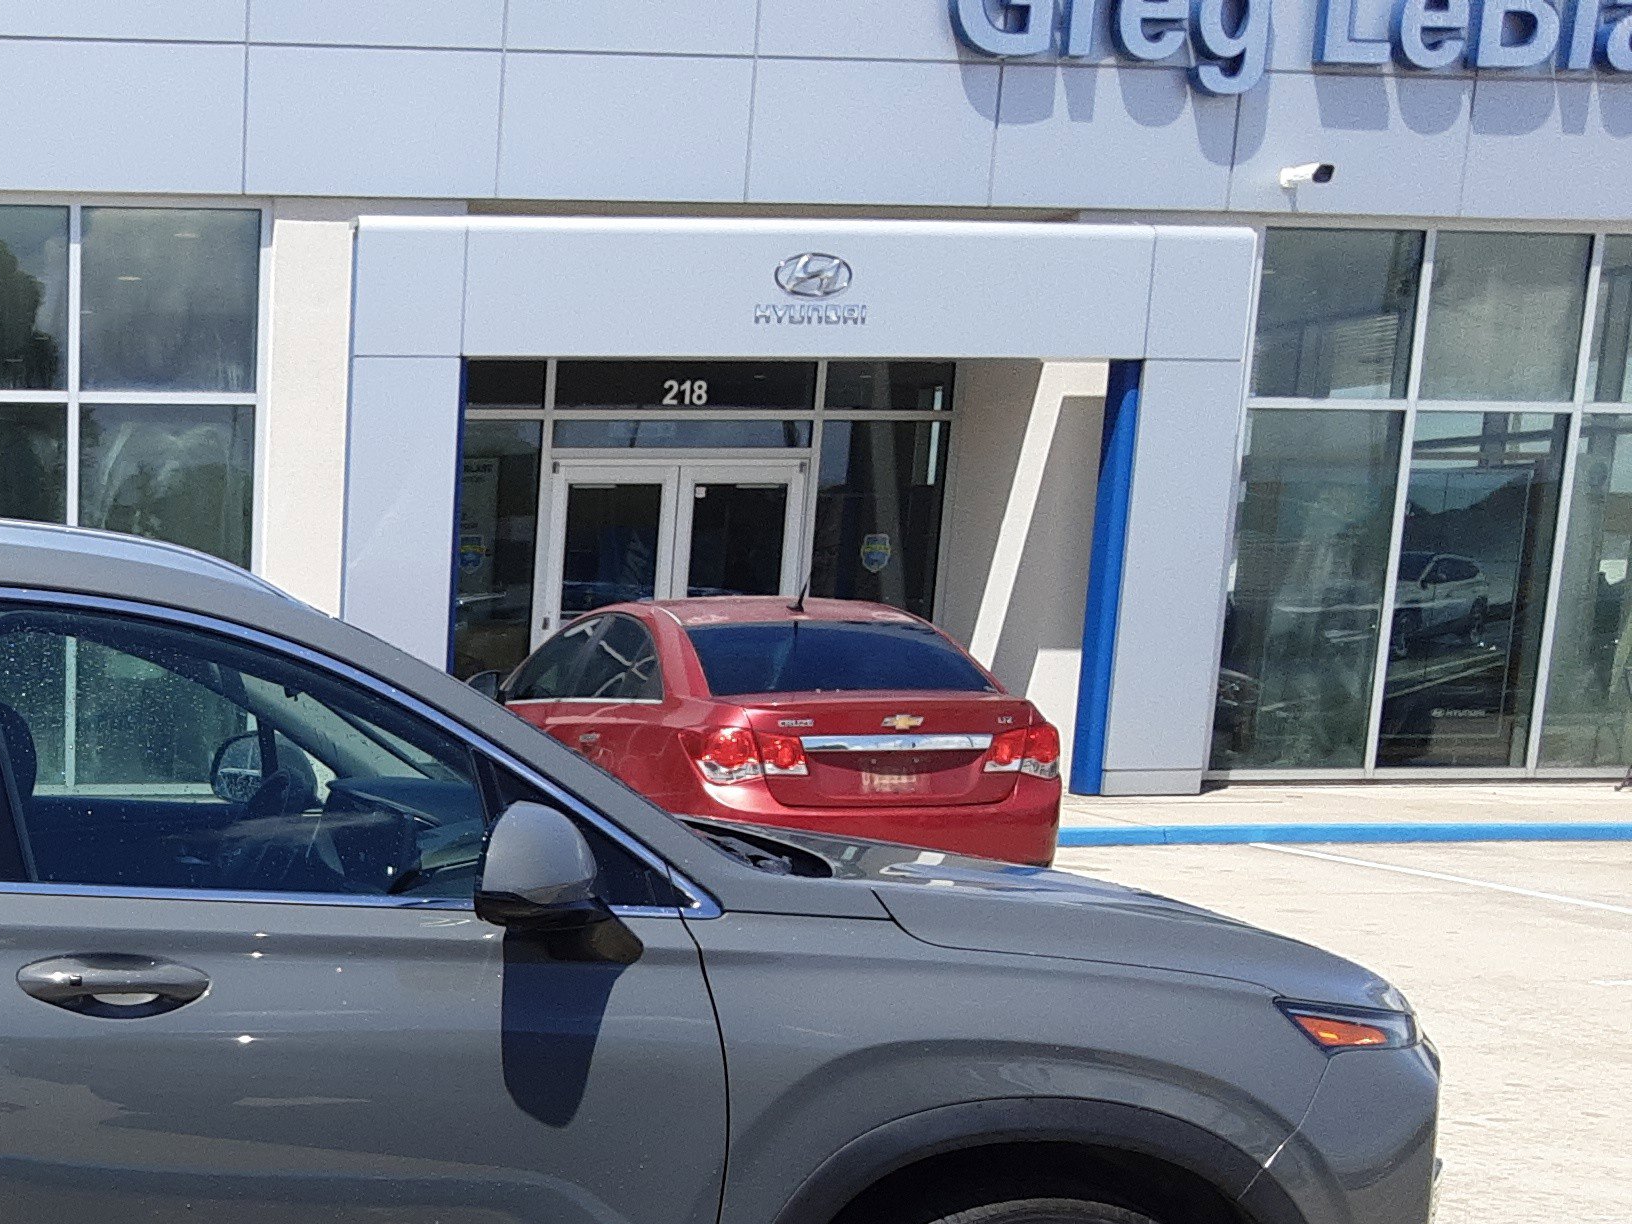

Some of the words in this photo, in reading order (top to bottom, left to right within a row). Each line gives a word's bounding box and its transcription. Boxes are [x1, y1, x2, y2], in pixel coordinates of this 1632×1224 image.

[948, 0, 1266, 95] Greg
[754, 303, 867, 325] HYUNDAI
[661, 379, 708, 406] 218
